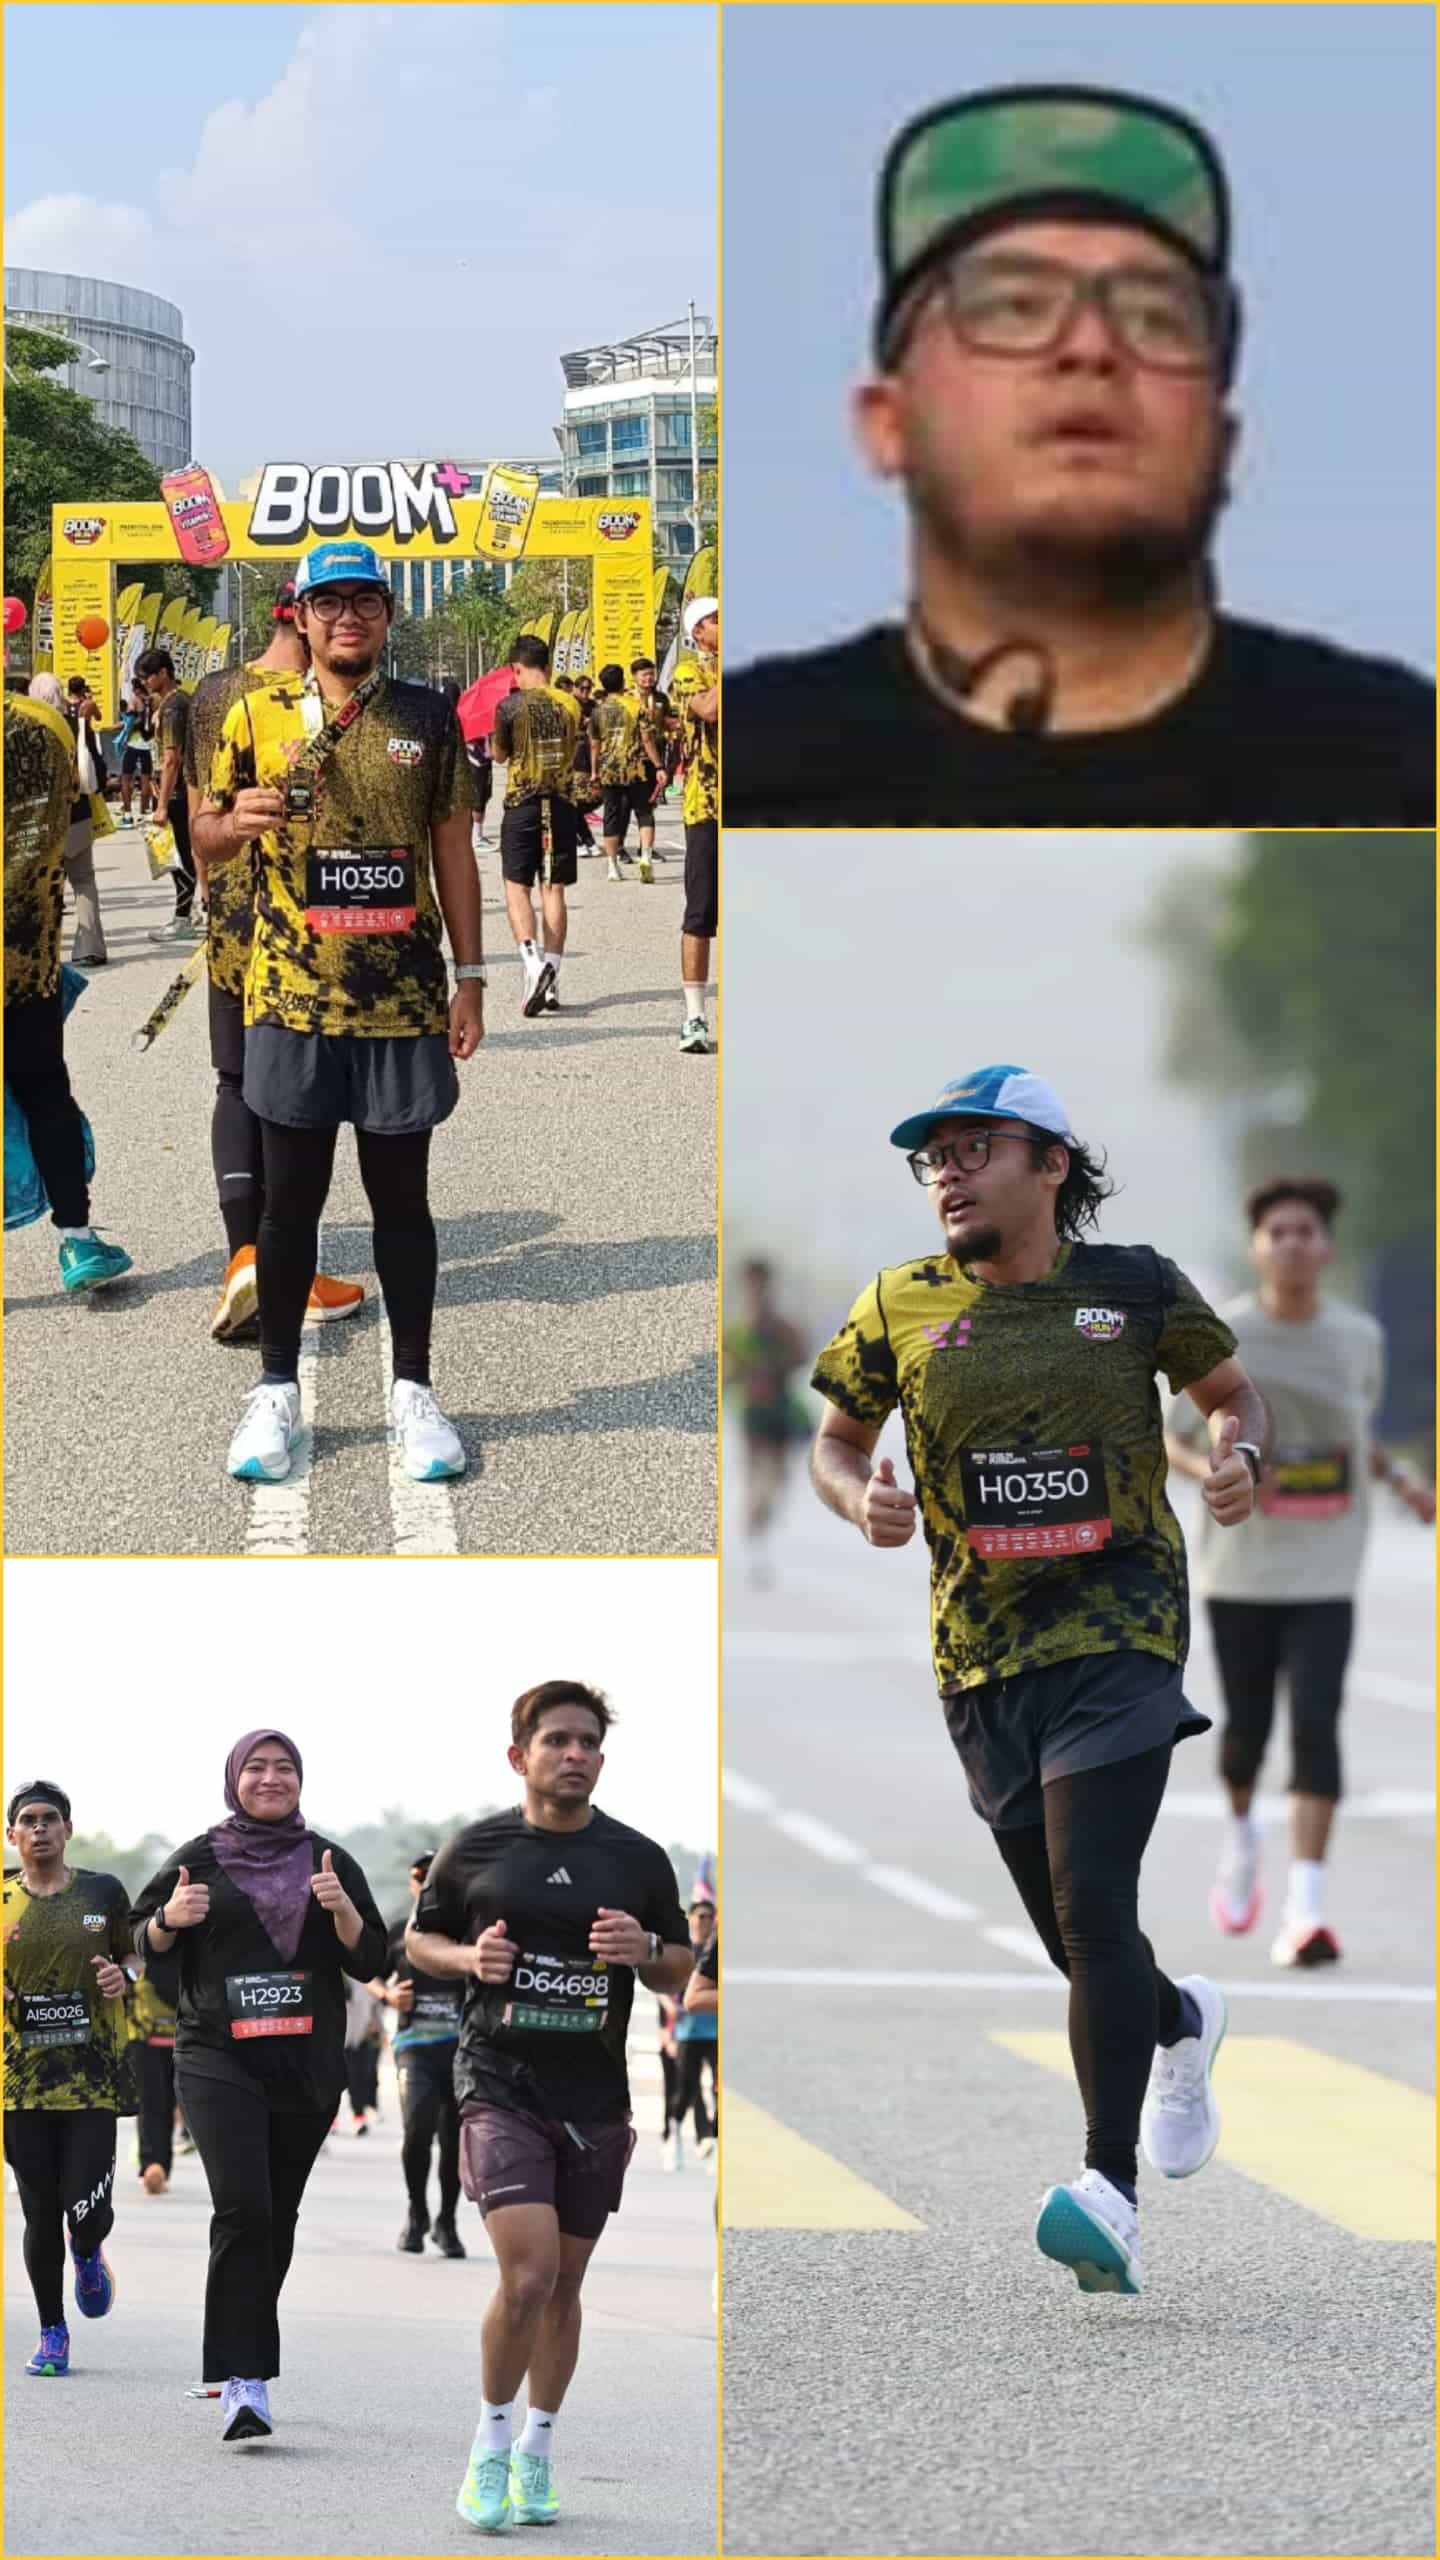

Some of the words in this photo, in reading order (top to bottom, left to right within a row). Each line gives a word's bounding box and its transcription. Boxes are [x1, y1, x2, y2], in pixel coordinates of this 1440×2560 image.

[321, 866, 404, 891] H0350
[979, 1467, 1089, 1504] H0350
[515, 1967, 609, 1996] D64698
[241, 1985, 303, 2008] H2923
